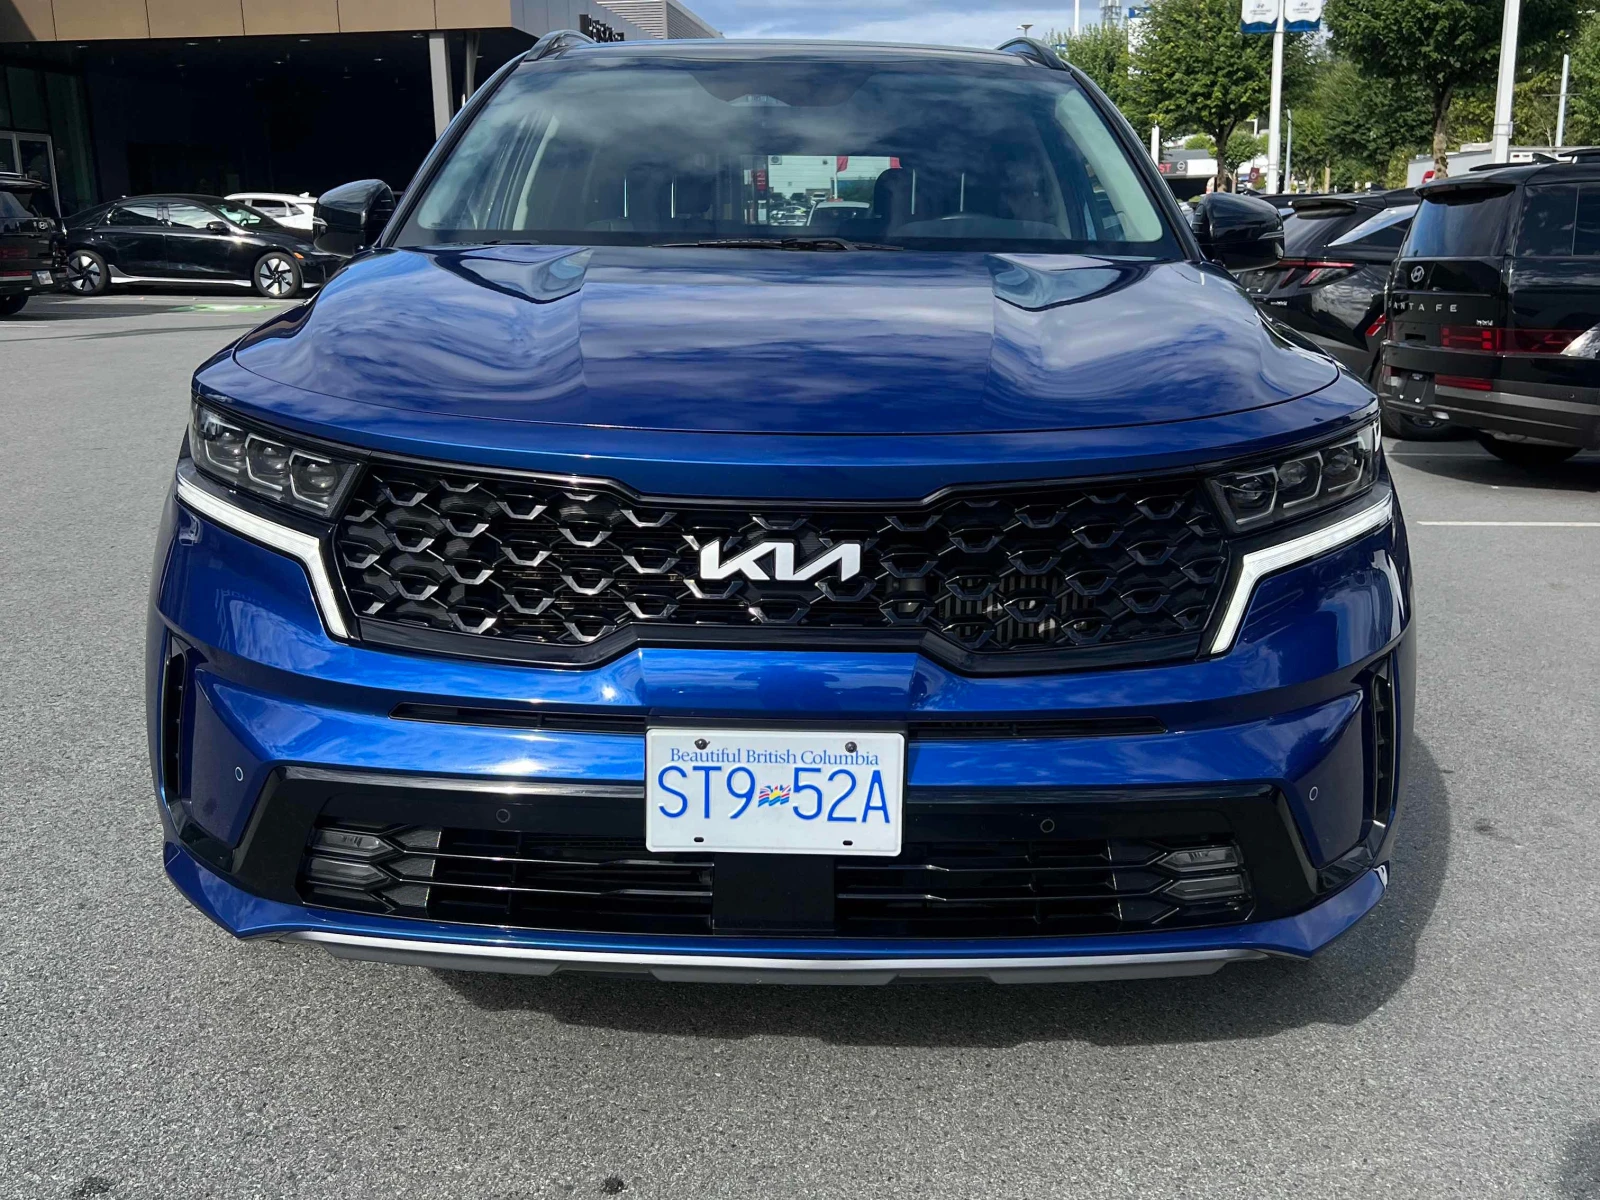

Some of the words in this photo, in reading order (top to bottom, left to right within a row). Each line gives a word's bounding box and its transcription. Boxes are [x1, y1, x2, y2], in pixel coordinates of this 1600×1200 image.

[1435, 303, 1458, 312] FE
[700, 539, 861, 582] KIA
[670, 748, 741, 763] Beautiful
[746, 749, 797, 764] British
[800, 750, 879, 766] Columbia
